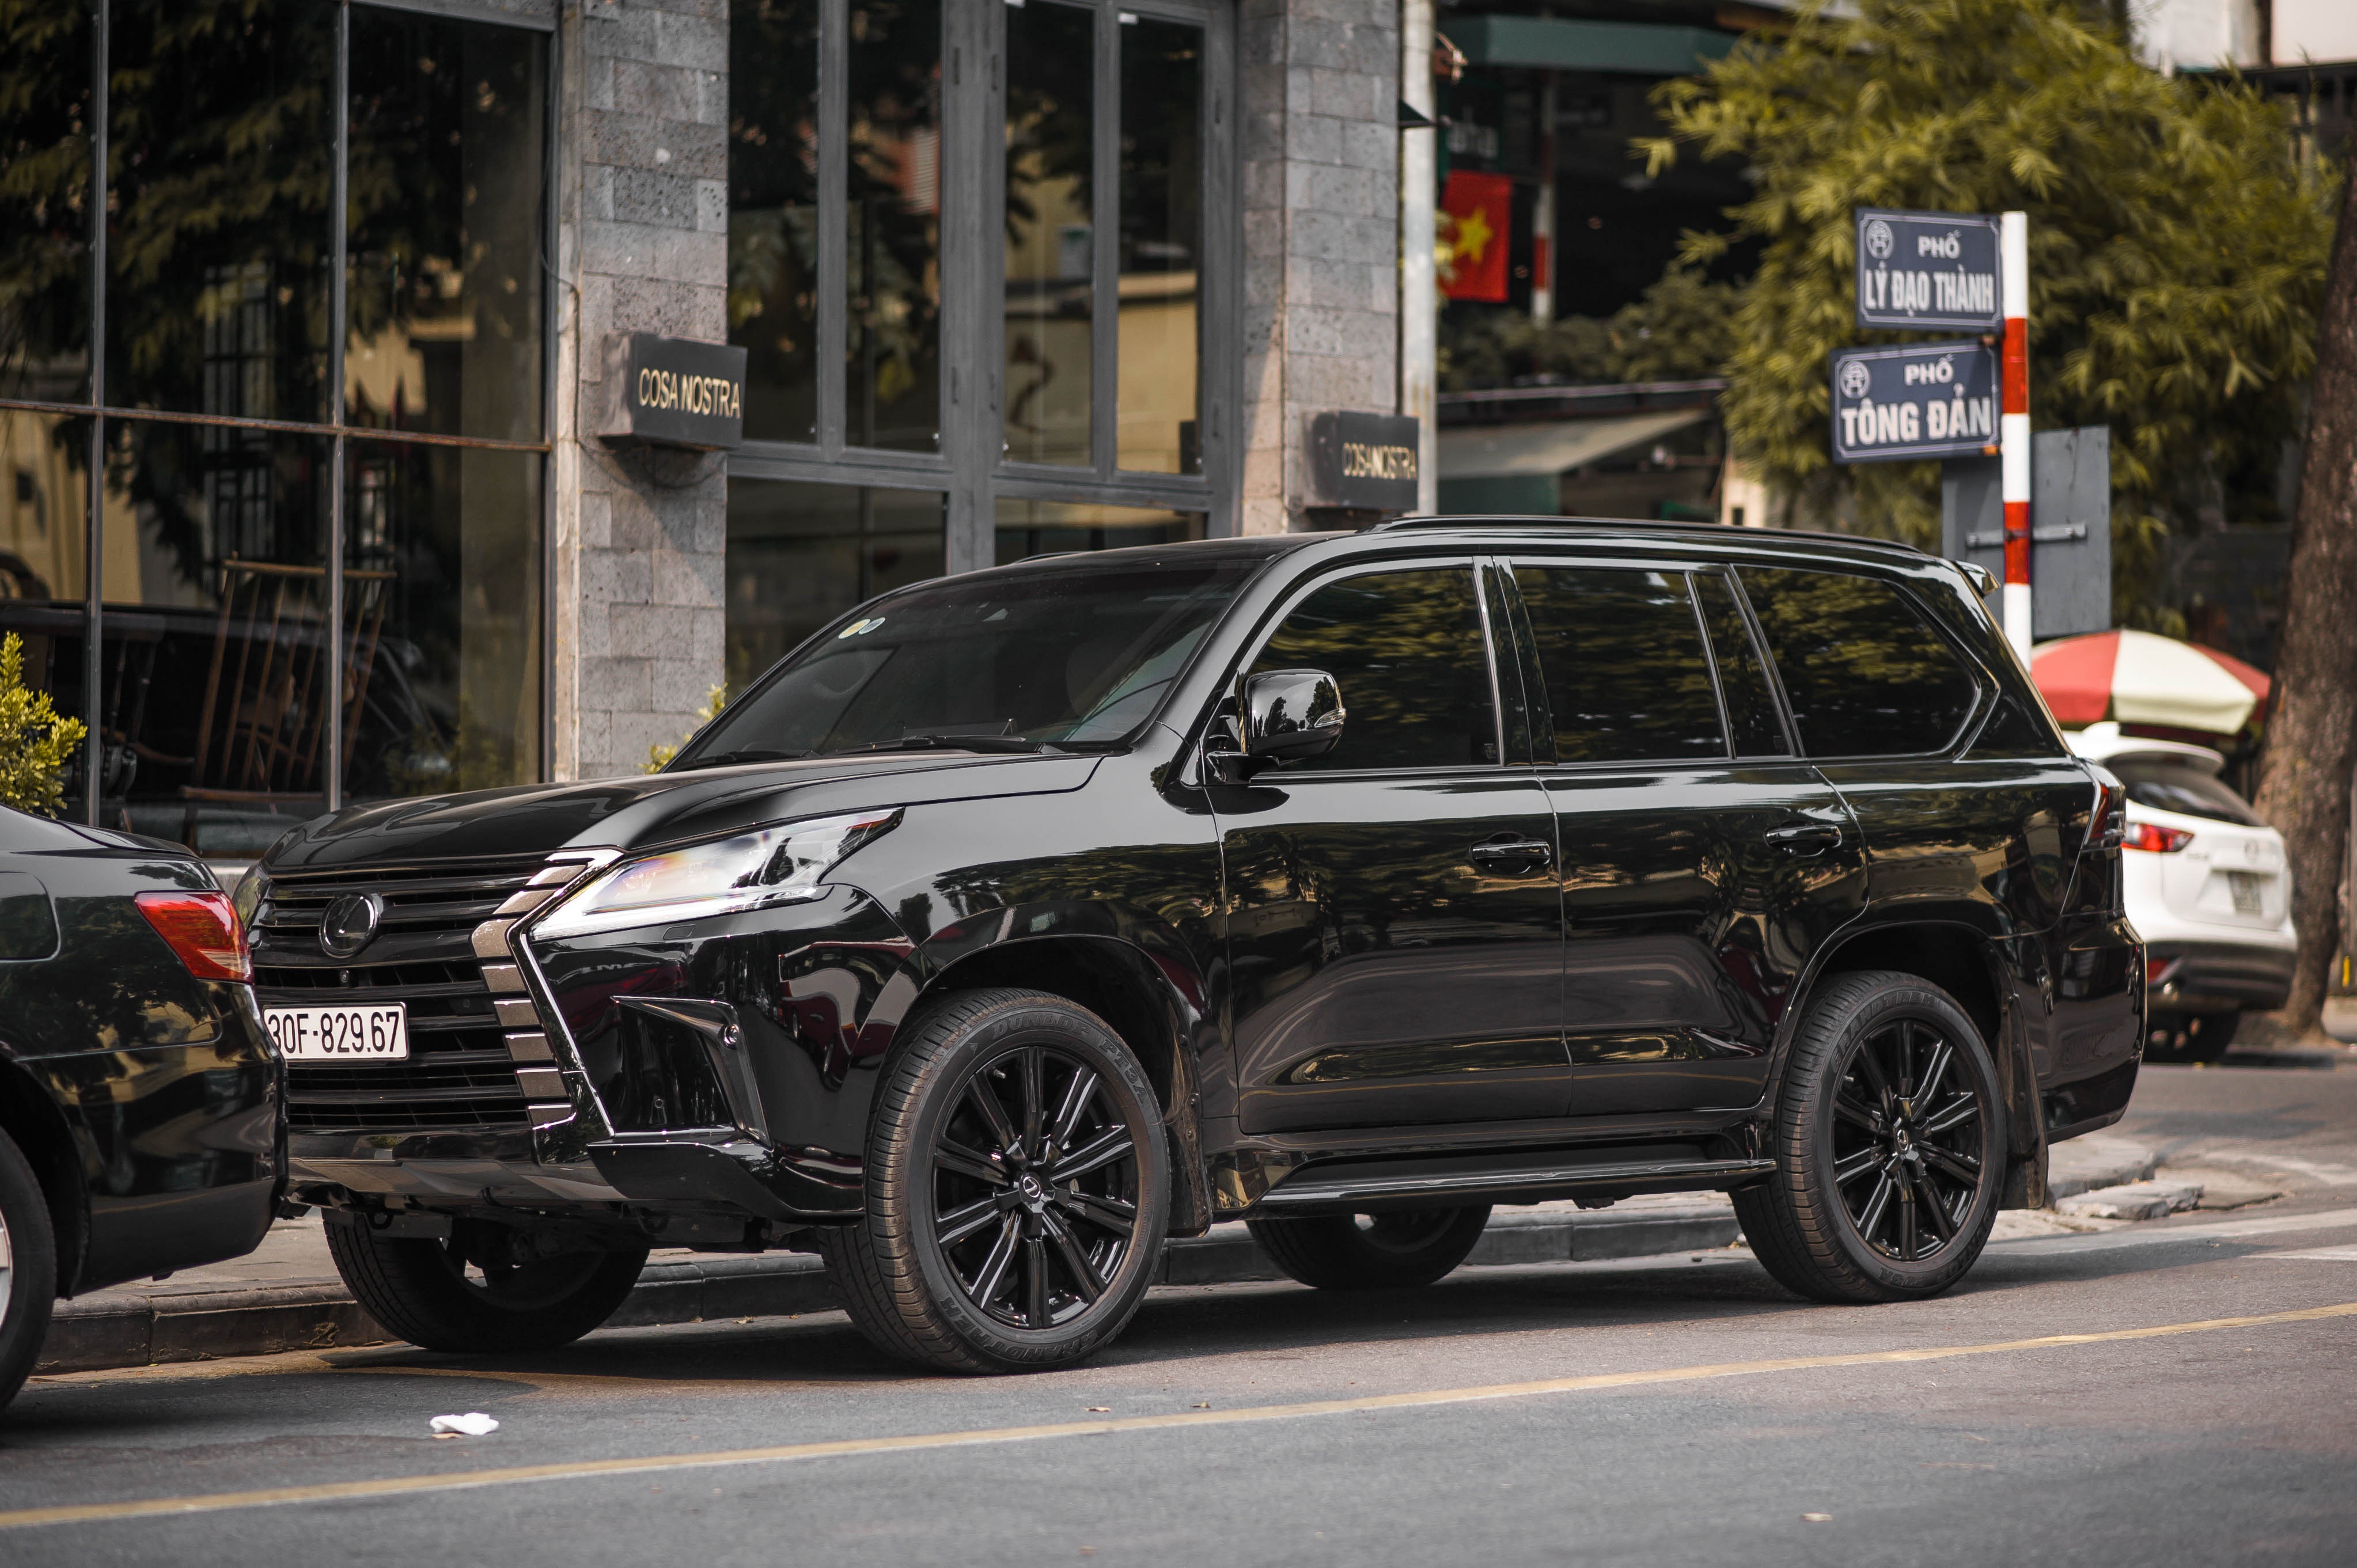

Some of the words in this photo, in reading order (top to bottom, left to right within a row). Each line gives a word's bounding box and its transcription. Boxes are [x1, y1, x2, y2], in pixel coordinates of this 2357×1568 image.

[1890, 269, 1930, 317] ĐẠO
[1934, 264, 1995, 313] THÀNH
[639, 368, 679, 410] COSA
[681, 374, 740, 419] NOSTRA
[1841, 398, 1920, 446] TÔNG
[1927, 384, 1991, 439] ĐẢN
[268, 1011, 399, 1054] 30F-829.67
[991, 1012, 1090, 1039] DUNLOP
